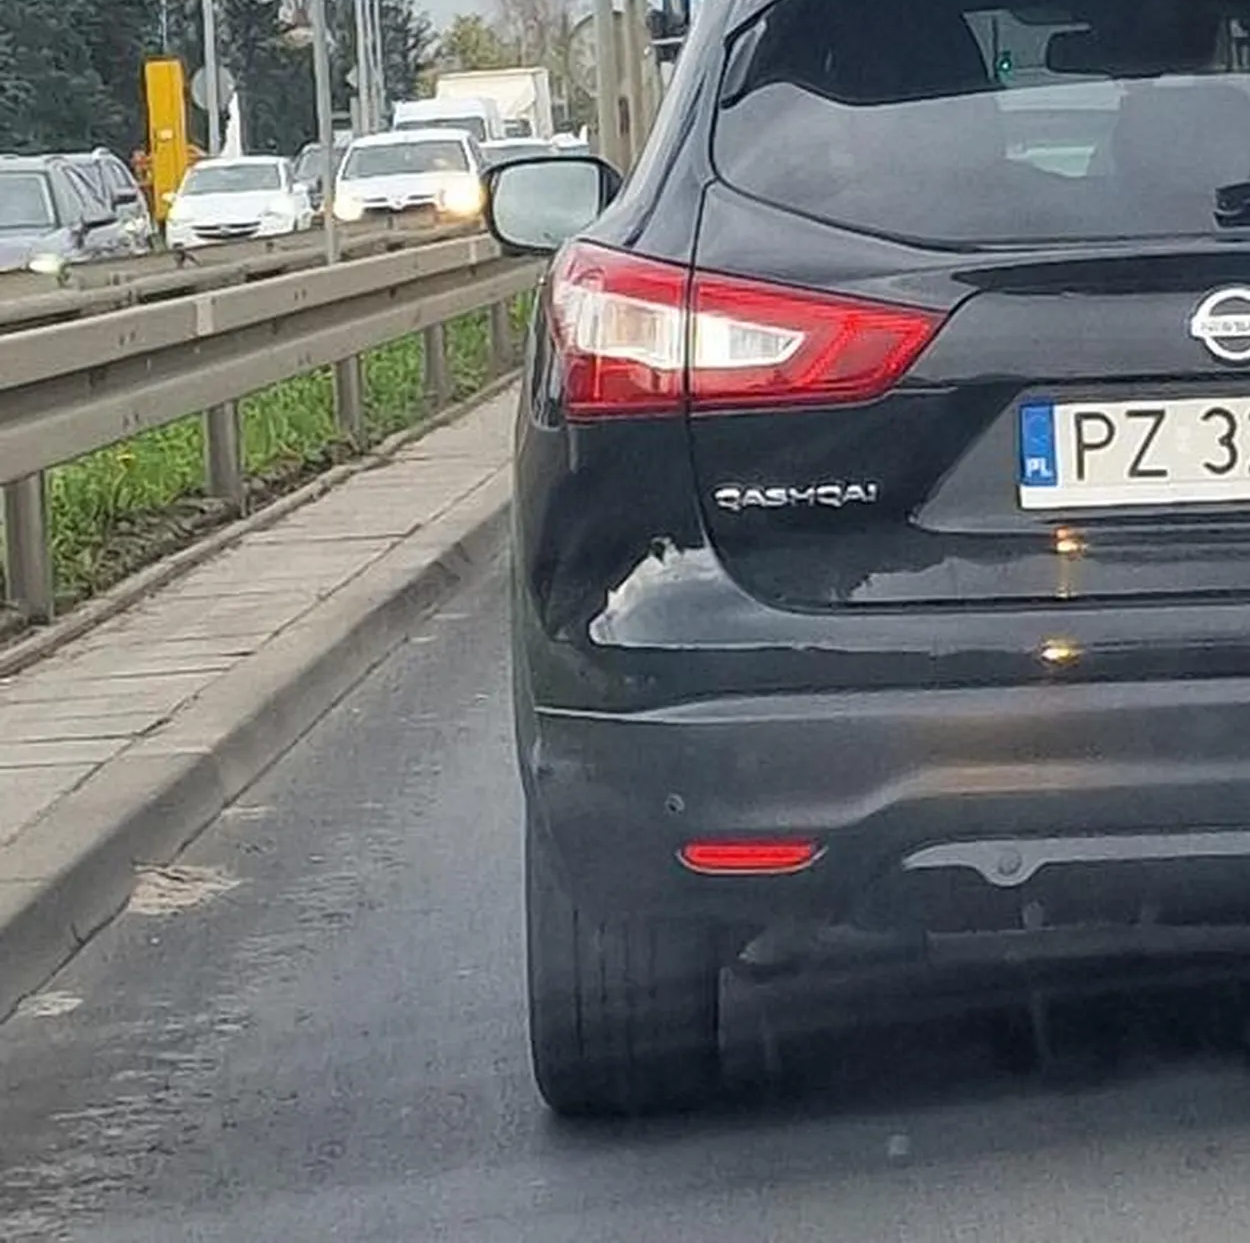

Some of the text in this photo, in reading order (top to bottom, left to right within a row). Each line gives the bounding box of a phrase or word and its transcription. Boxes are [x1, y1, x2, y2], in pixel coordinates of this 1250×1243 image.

[1073, 408, 1169, 481] PZ
[1026, 458, 1051, 478] PL
[715, 484, 878, 511] QASHQAI
